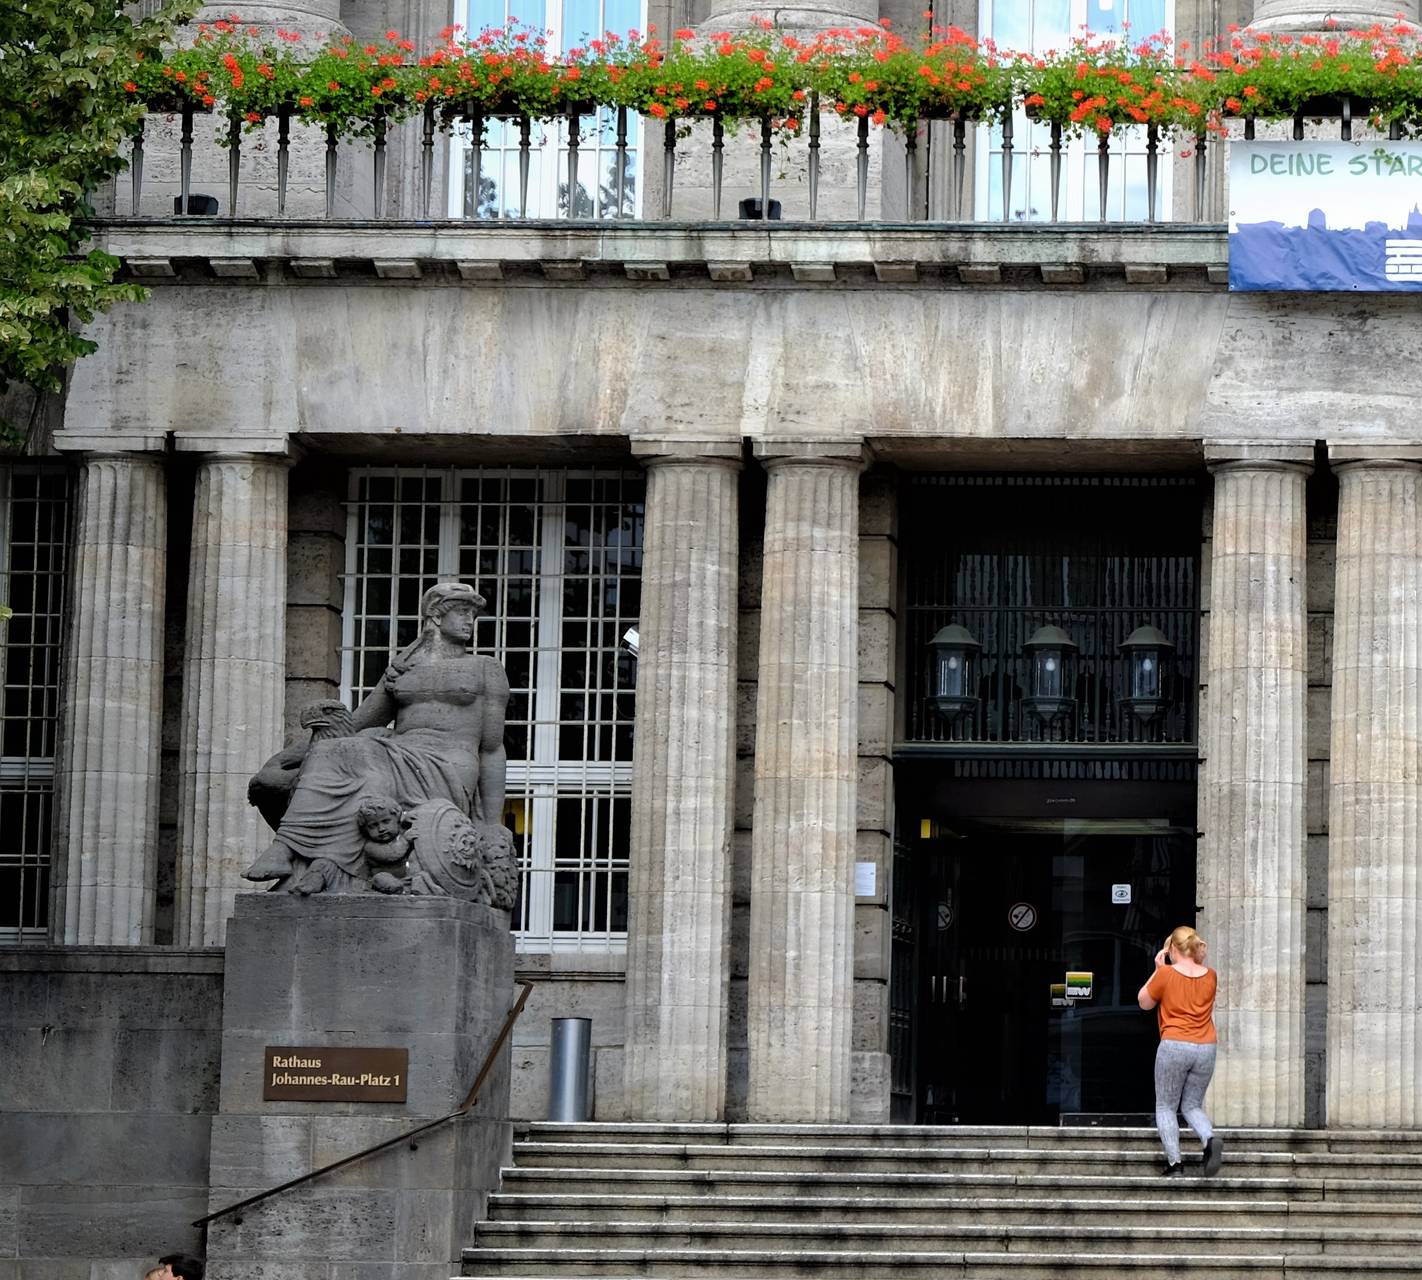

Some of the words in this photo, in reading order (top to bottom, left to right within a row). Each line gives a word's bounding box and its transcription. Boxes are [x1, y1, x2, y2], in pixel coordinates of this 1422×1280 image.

[1250, 153, 1334, 177] DEINE
[272, 1055, 322, 1068] Rathaus
[271, 1072, 391, 1087] Johannes-Rau-Platz
[394, 1074, 400, 1086] 1
